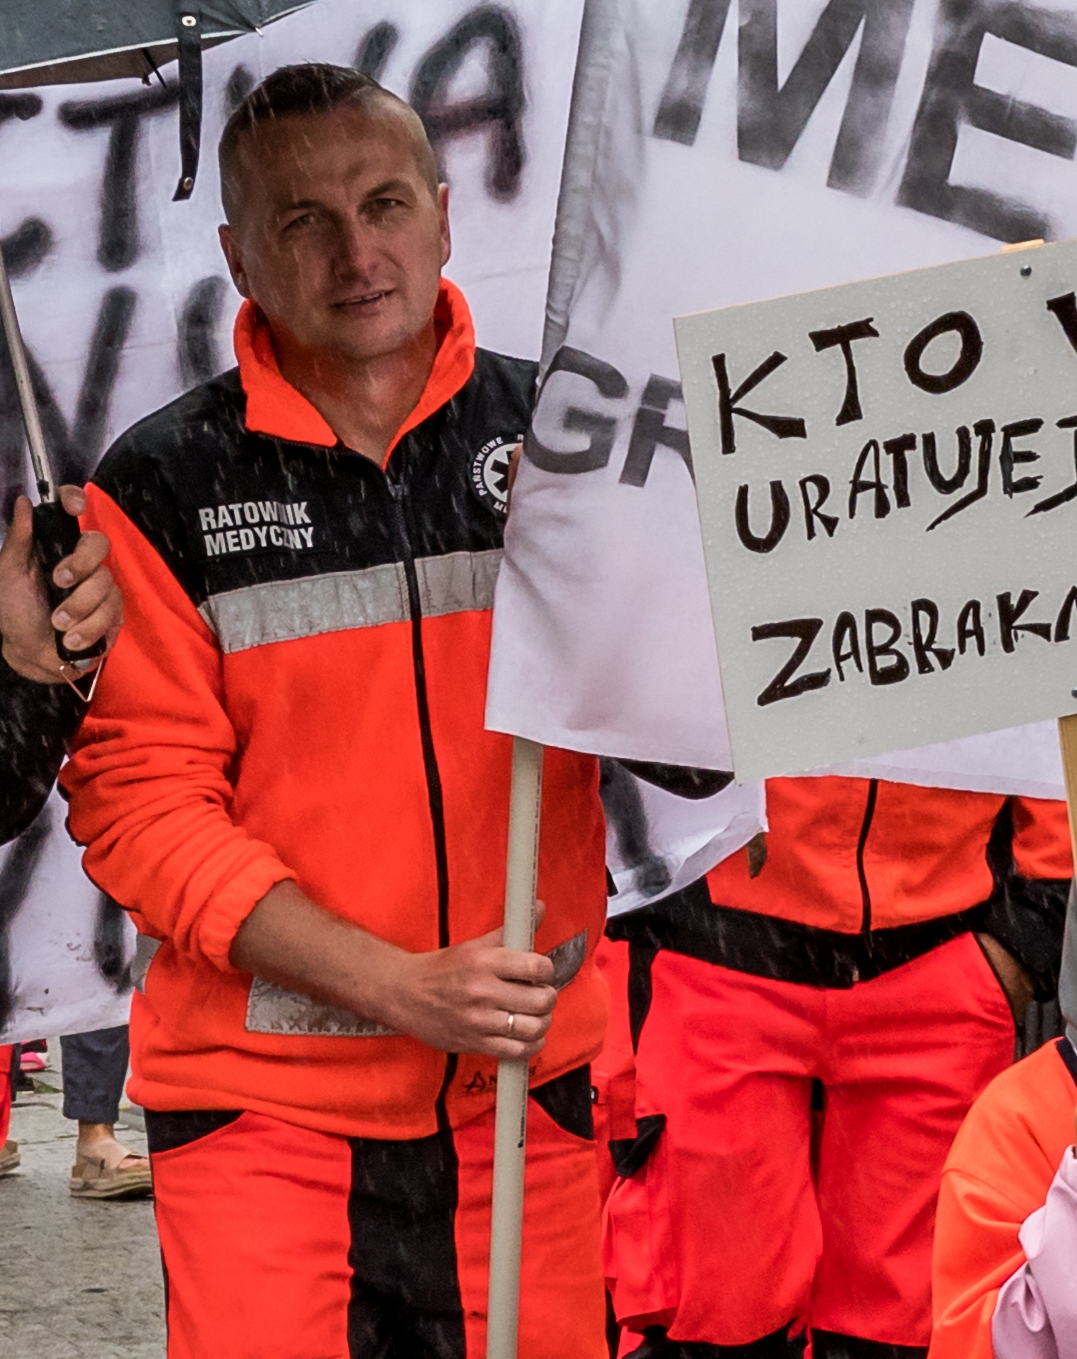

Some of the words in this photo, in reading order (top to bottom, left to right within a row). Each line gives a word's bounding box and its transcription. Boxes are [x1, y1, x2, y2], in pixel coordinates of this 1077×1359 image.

[711, 311, 985, 456] KTO
[199, 501, 312, 531] RATOWNIK
[204, 526, 314, 556] MEDYCZNY
